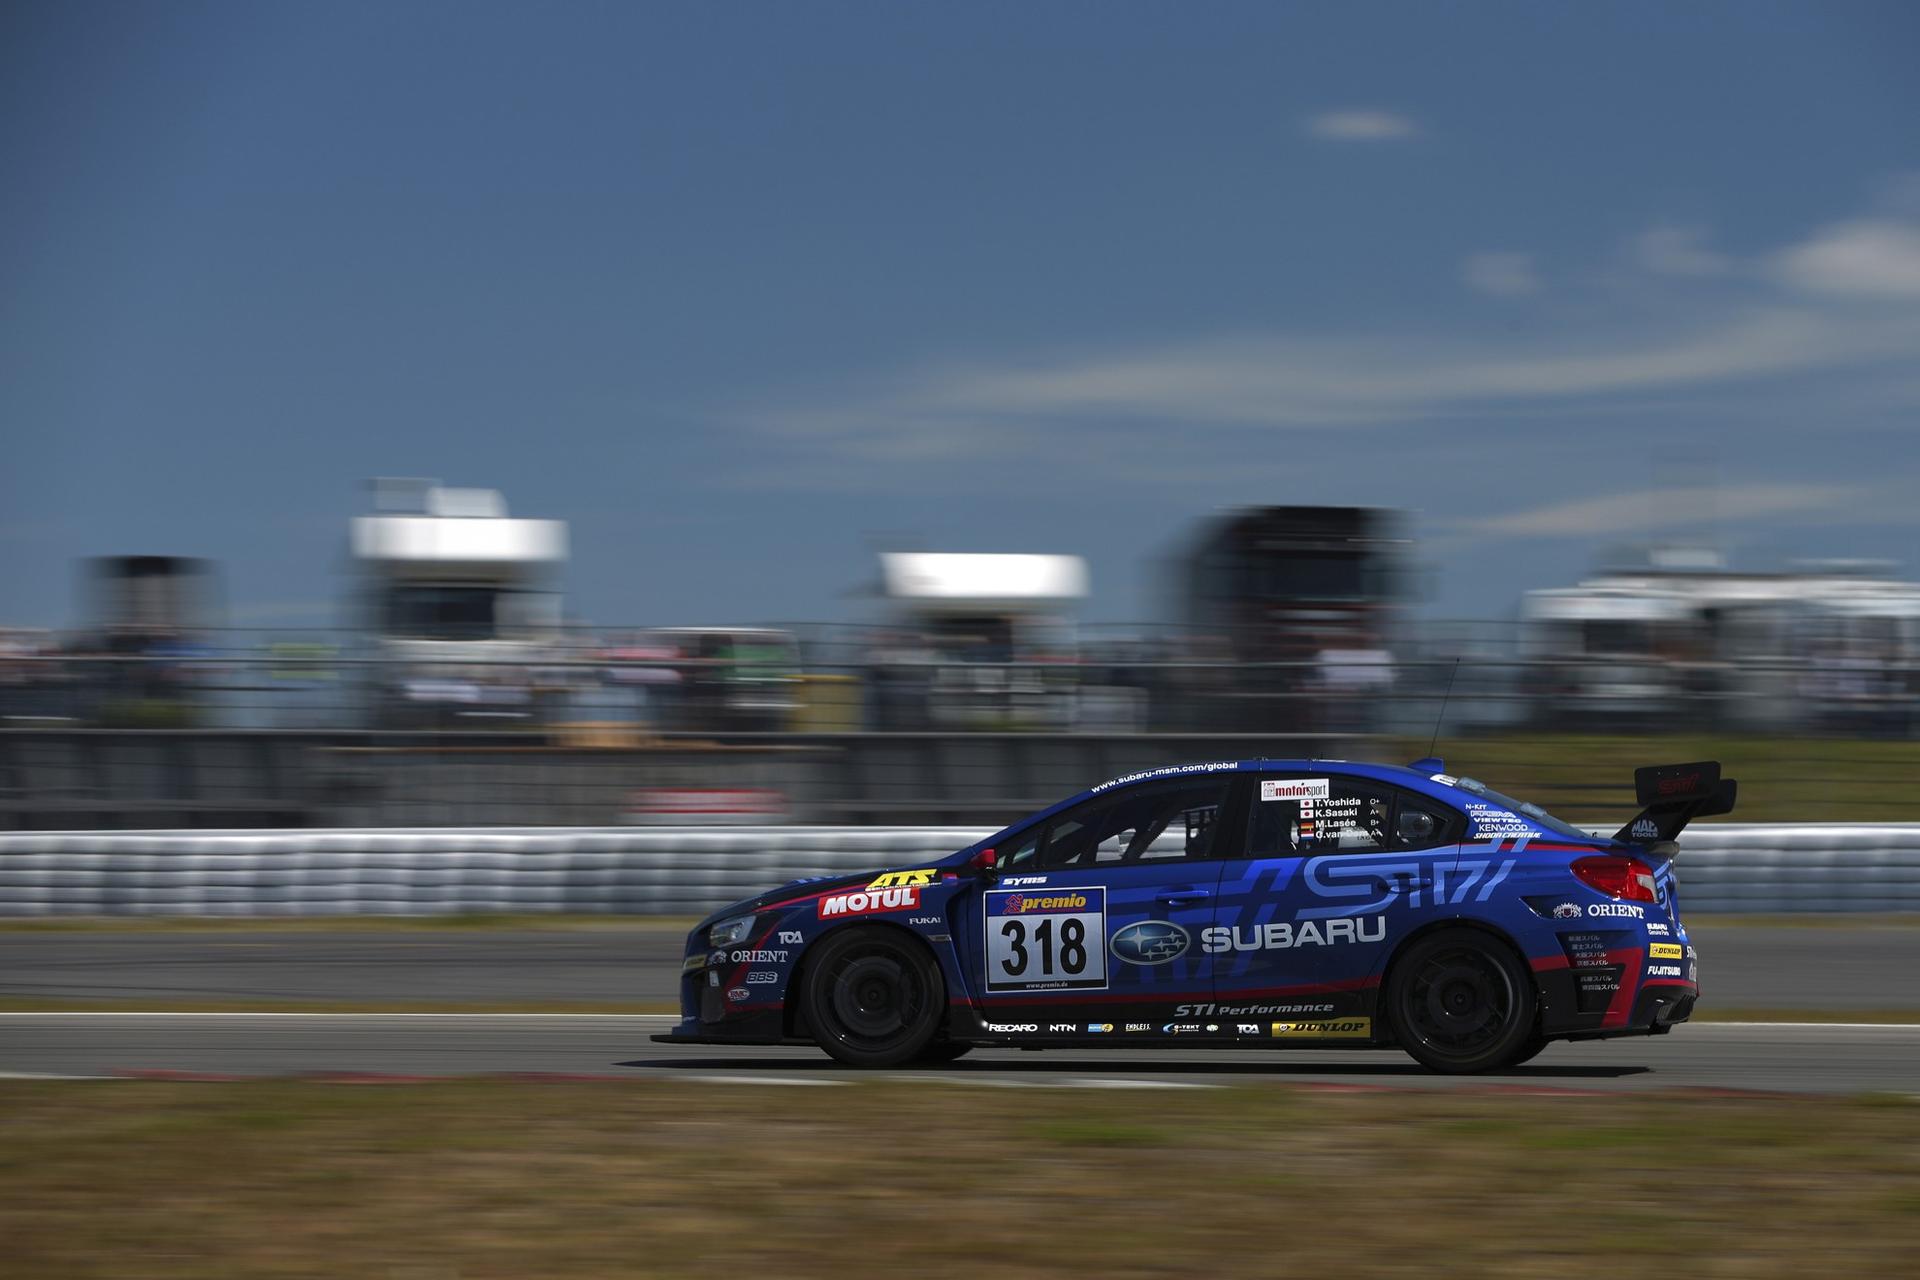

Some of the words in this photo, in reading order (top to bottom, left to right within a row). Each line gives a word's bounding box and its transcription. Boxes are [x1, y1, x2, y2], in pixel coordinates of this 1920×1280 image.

[1091, 761, 1238, 793] www.subaru-msm.com/global
[1275, 782, 1327, 797] motorsport
[1315, 797, 1361, 807] T.Yoshida
[1315, 808, 1358, 817] K.Sasaki
[1315, 818, 1357, 828] M.Lasée
[1478, 824, 1529, 832] KENWOOD
[1631, 820, 1659, 832] MAC
[867, 869, 938, 888] ATS
[822, 887, 916, 916] MOTUL
[1020, 893, 1087, 913] premio
[1587, 904, 1644, 919] ORIENT
[908, 916, 941, 925] FUKAI
[778, 930, 804, 944] TOA
[1200, 915, 1387, 953] SUBARU
[1001, 917, 1087, 976] 318
[1658, 947, 1681, 955] DUNLOP
[731, 950, 789, 963] ORIENT
[1647, 965, 1682, 976] FUJITSUBO
[746, 971, 778, 984] BBS
[1026, 981, 1069, 989] www.premio.de
[1174, 1003, 1216, 1017] STI
[1218, 1003, 1335, 1016] Performance
[988, 1023, 1039, 1032] RECARO
[1049, 1023, 1077, 1032] NTN
[1236, 1024, 1260, 1034] TOA
[1293, 1022, 1365, 1032] DUNLOP
